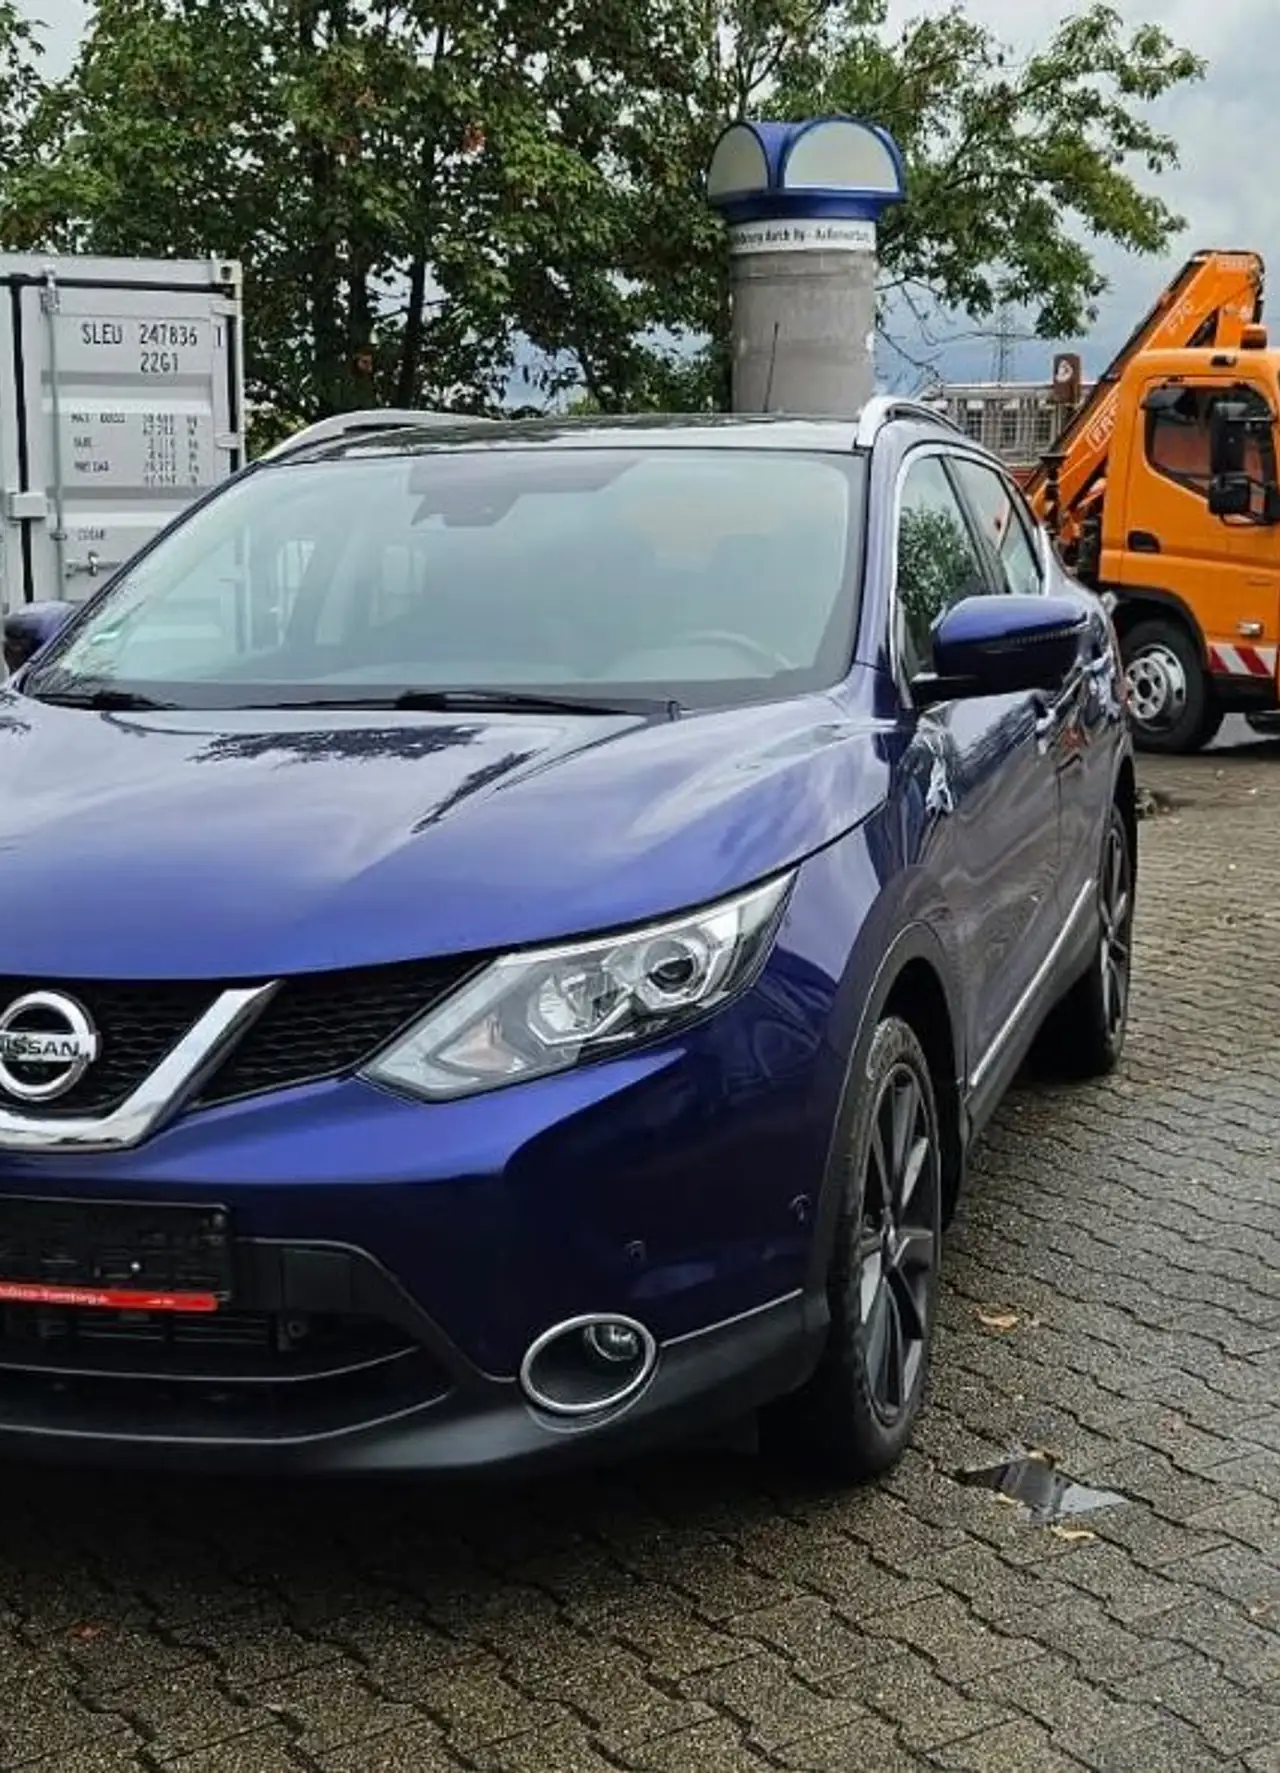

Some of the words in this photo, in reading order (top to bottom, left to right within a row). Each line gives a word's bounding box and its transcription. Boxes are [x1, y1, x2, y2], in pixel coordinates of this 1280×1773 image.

[81, 323, 124, 345] SLEU
[139, 323, 199, 347] 247836
[140, 351, 180, 374] 22G1
